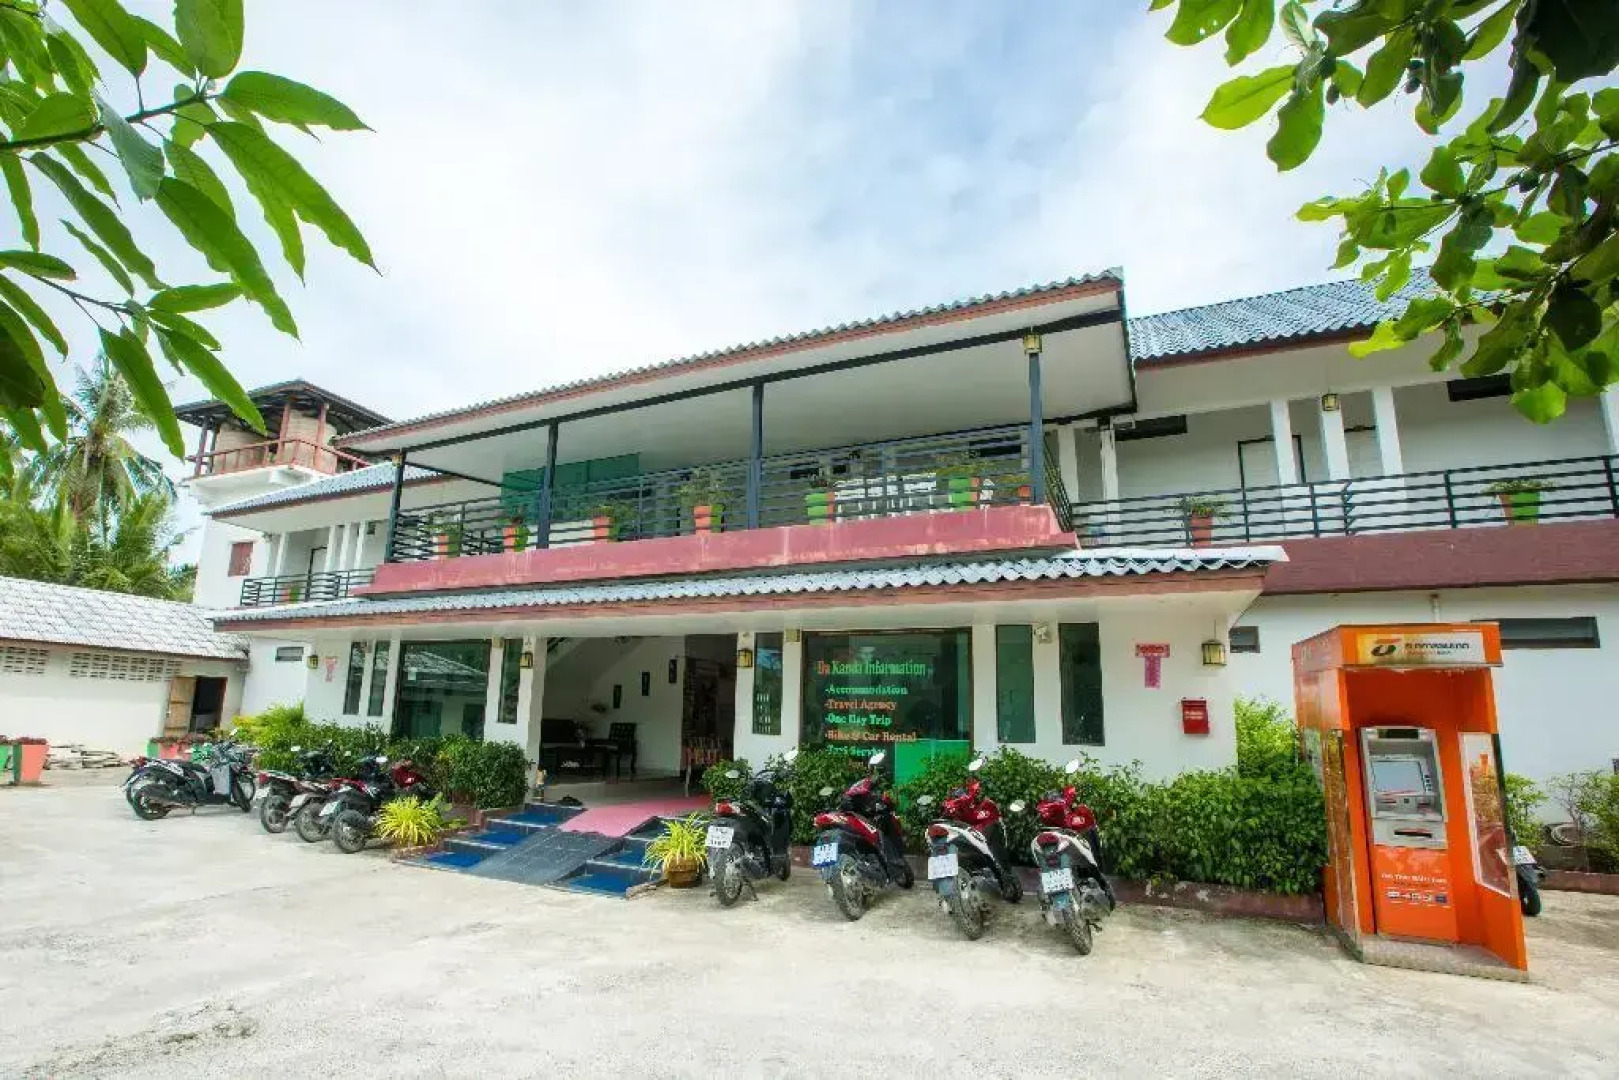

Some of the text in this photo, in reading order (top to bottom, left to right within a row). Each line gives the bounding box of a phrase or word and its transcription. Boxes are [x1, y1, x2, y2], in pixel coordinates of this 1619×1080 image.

[864, 659, 926, 676] Information
[859, 699, 897, 711] Agency
[869, 714, 892, 726] Trip
[863, 731, 880, 741] Car
[882, 731, 917, 742] Rental
